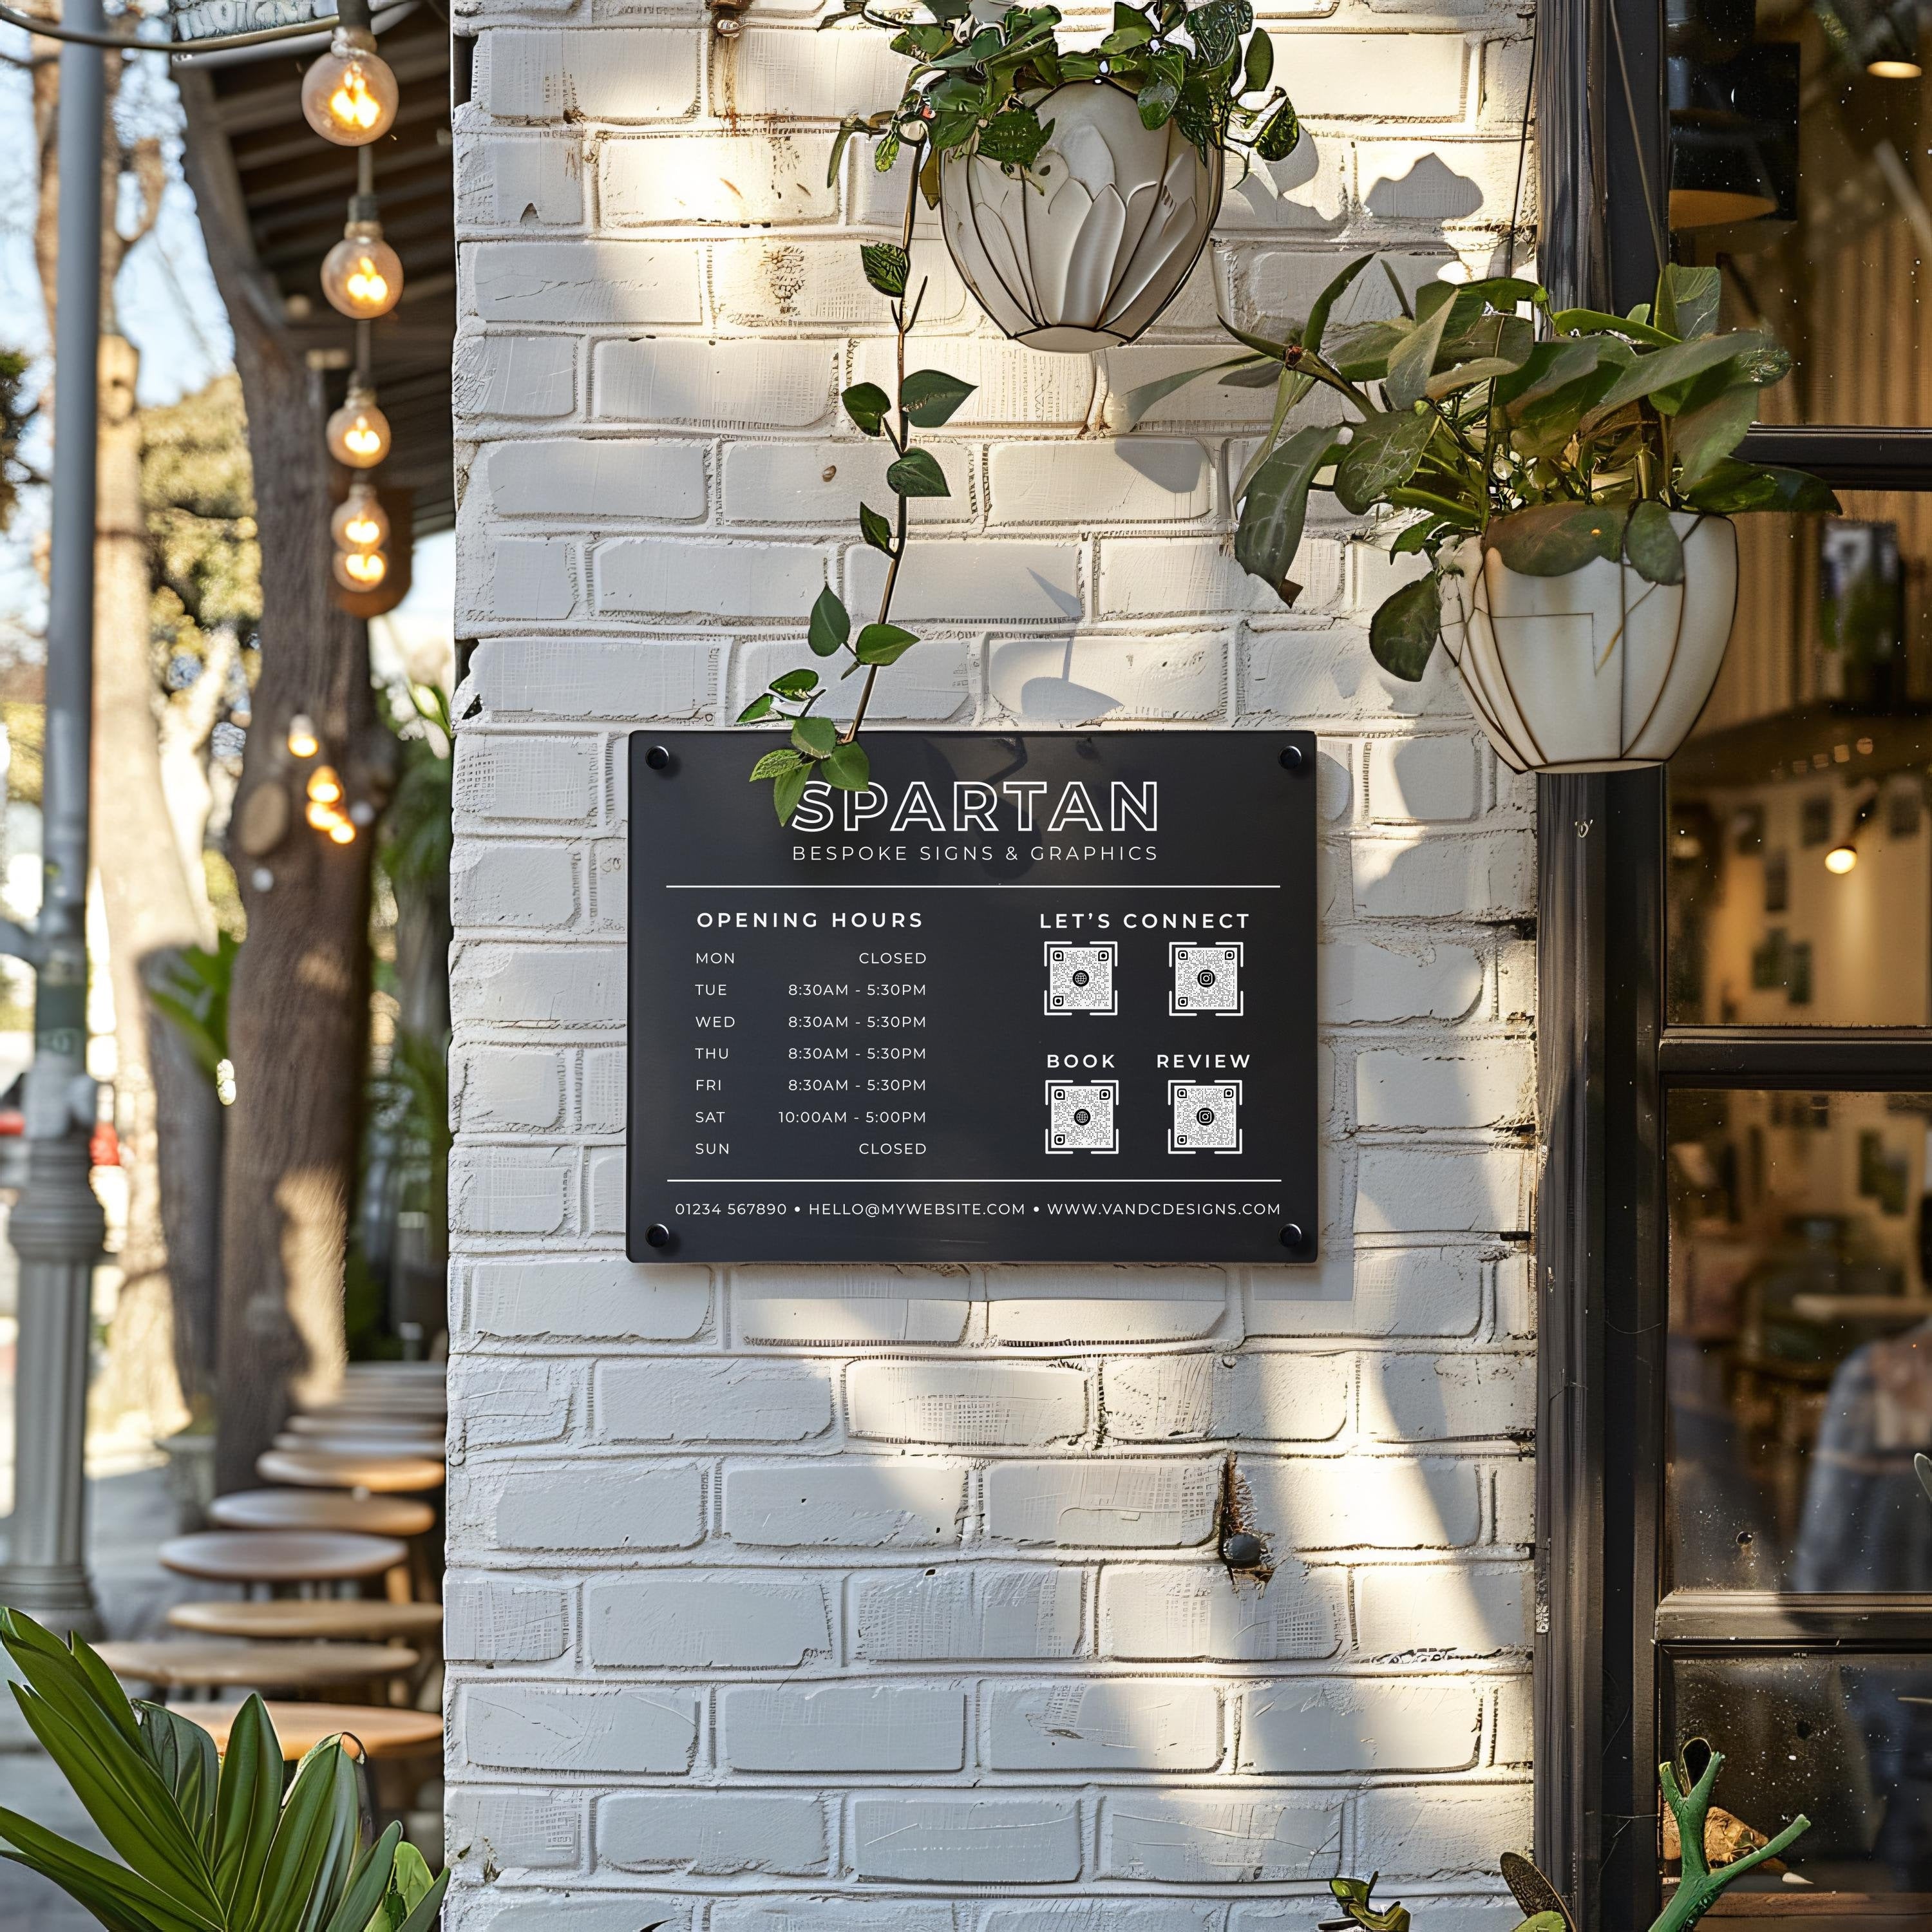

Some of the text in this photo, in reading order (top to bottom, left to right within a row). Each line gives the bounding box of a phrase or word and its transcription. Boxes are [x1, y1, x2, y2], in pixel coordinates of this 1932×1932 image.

[791, 781, 1158, 832] SPARTAN
[793, 846, 1157, 860] BESPOKE SIGNS & GRAPHICS
[697, 912, 922, 928] OPENING HOURS
[1123, 913, 1249, 929] CONNECT
[696, 952, 927, 964] MON CLOSED
[694, 984, 727, 996] TUE
[788, 984, 848, 996] 8:30AM
[867, 984, 925, 996] 5:30PM
[695, 1016, 735, 1028] WED
[788, 1016, 848, 1028] 8:30AM
[867, 1016, 925, 1028] 5:30PM
[694, 1048, 728, 1059] THU
[788, 1048, 848, 1059] 8:30AM
[867, 1048, 925, 1059] 5:30PM
[1047, 1054, 1115, 1068] BOOK
[1157, 1054, 1250, 1068] REVIEW
[696, 1079, 721, 1091] FRI
[788, 1079, 848, 1091] 8:30AM
[867, 1079, 925, 1091] 5:30PM
[695, 1111, 726, 1123] SAT
[778, 1111, 846, 1123] 10:00AM
[866, 1111, 925, 1123] 5:00PM
[695, 1143, 927, 1155] SUN CLOSED
[675, 1203, 1280, 1218] 01234 567890 HELLO@MYWEBSITE.COM WWW.VANDCDESIGNS.COM
